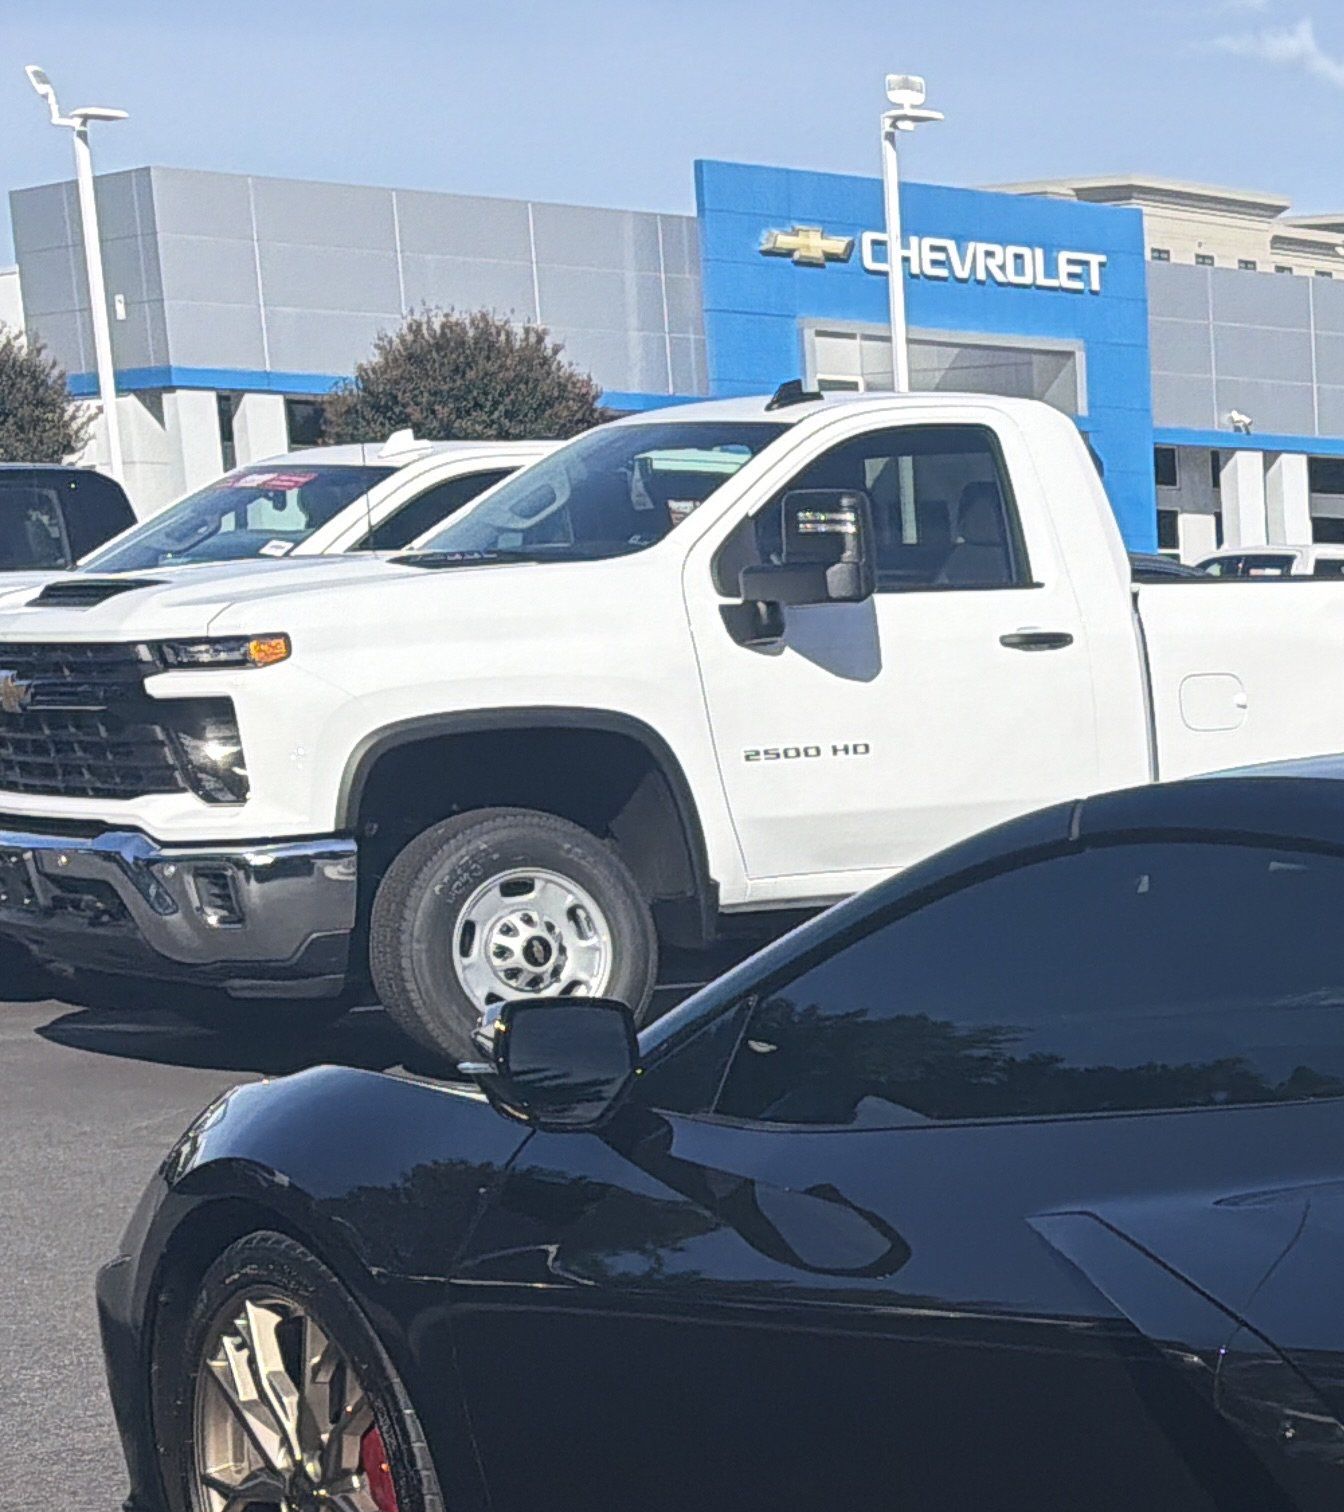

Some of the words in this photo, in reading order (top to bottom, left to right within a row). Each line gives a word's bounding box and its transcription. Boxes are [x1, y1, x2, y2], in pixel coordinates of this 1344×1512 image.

[861, 231, 1107, 293] CHEVROLET
[743, 746, 822, 762] 2500
[831, 743, 870, 756] HD
